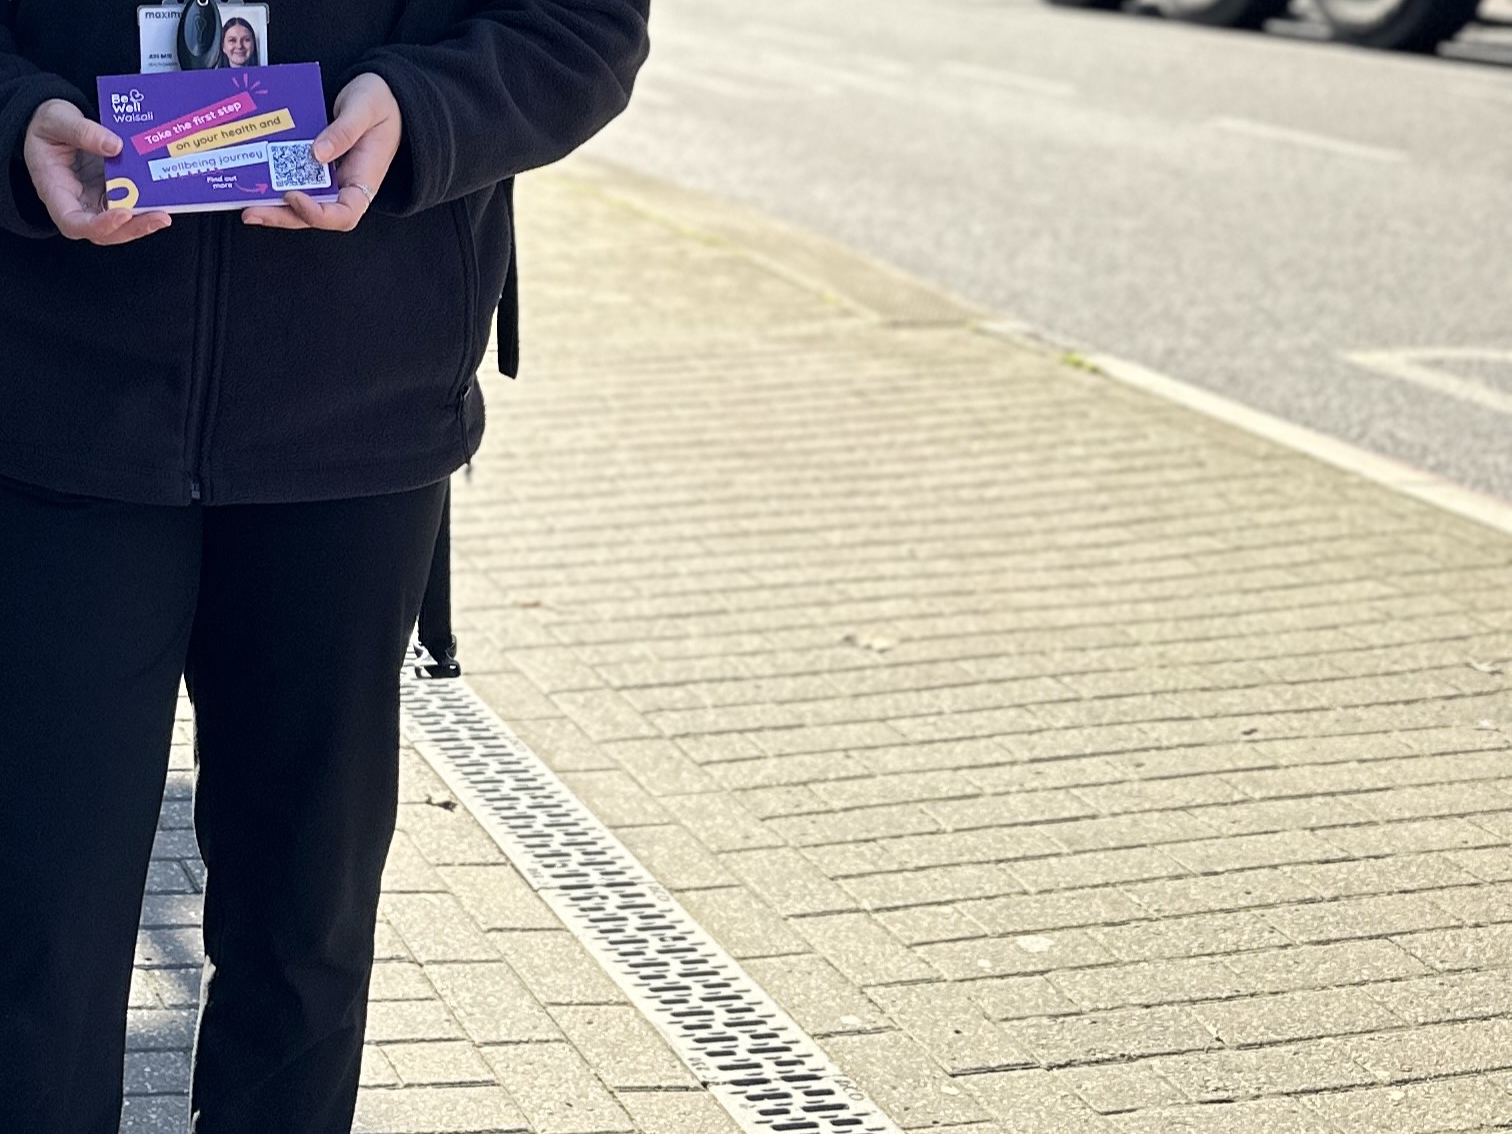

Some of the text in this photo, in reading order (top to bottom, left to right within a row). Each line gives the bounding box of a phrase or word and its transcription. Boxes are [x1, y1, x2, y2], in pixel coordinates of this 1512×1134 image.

[112, 101, 141, 114] Well
[113, 111, 154, 123] Walsall
[145, 102, 242, 145] Take the first step
[175, 116, 281, 151] on your health and
[161, 150, 263, 173] wellbeing journey
